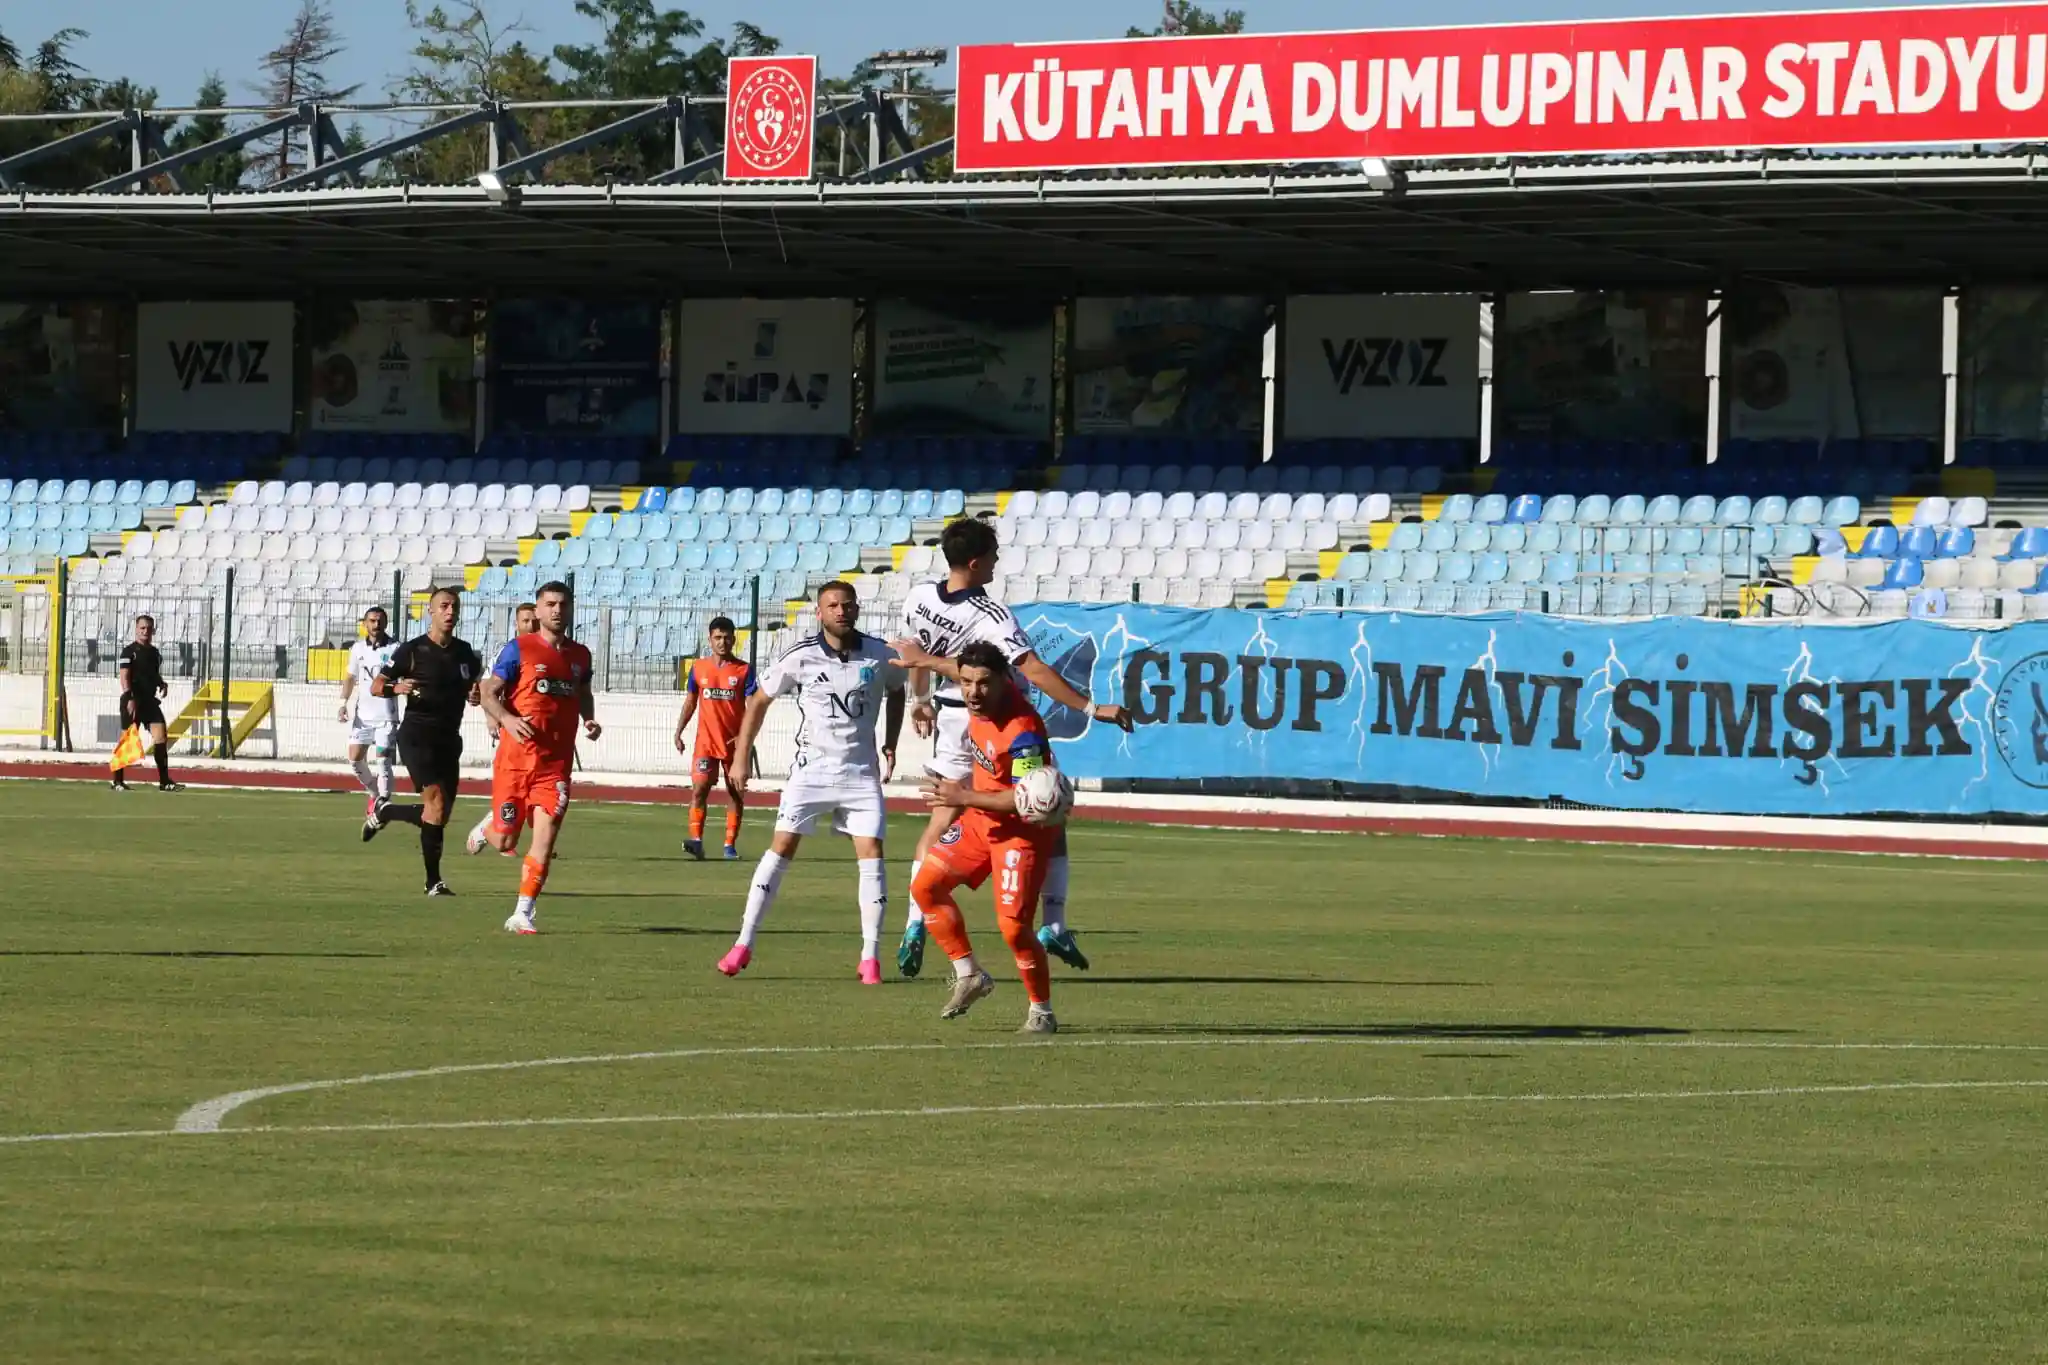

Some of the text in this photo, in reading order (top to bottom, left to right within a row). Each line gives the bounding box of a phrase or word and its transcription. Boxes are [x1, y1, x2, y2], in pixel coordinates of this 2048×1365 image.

[983, 33, 2048, 143] KÜTAHYA DUMLUPINAR STADYU
[825, 689, 866, 719] NG
[1122, 646, 1973, 786] GRUP MAVİ ŞİMŞEK
